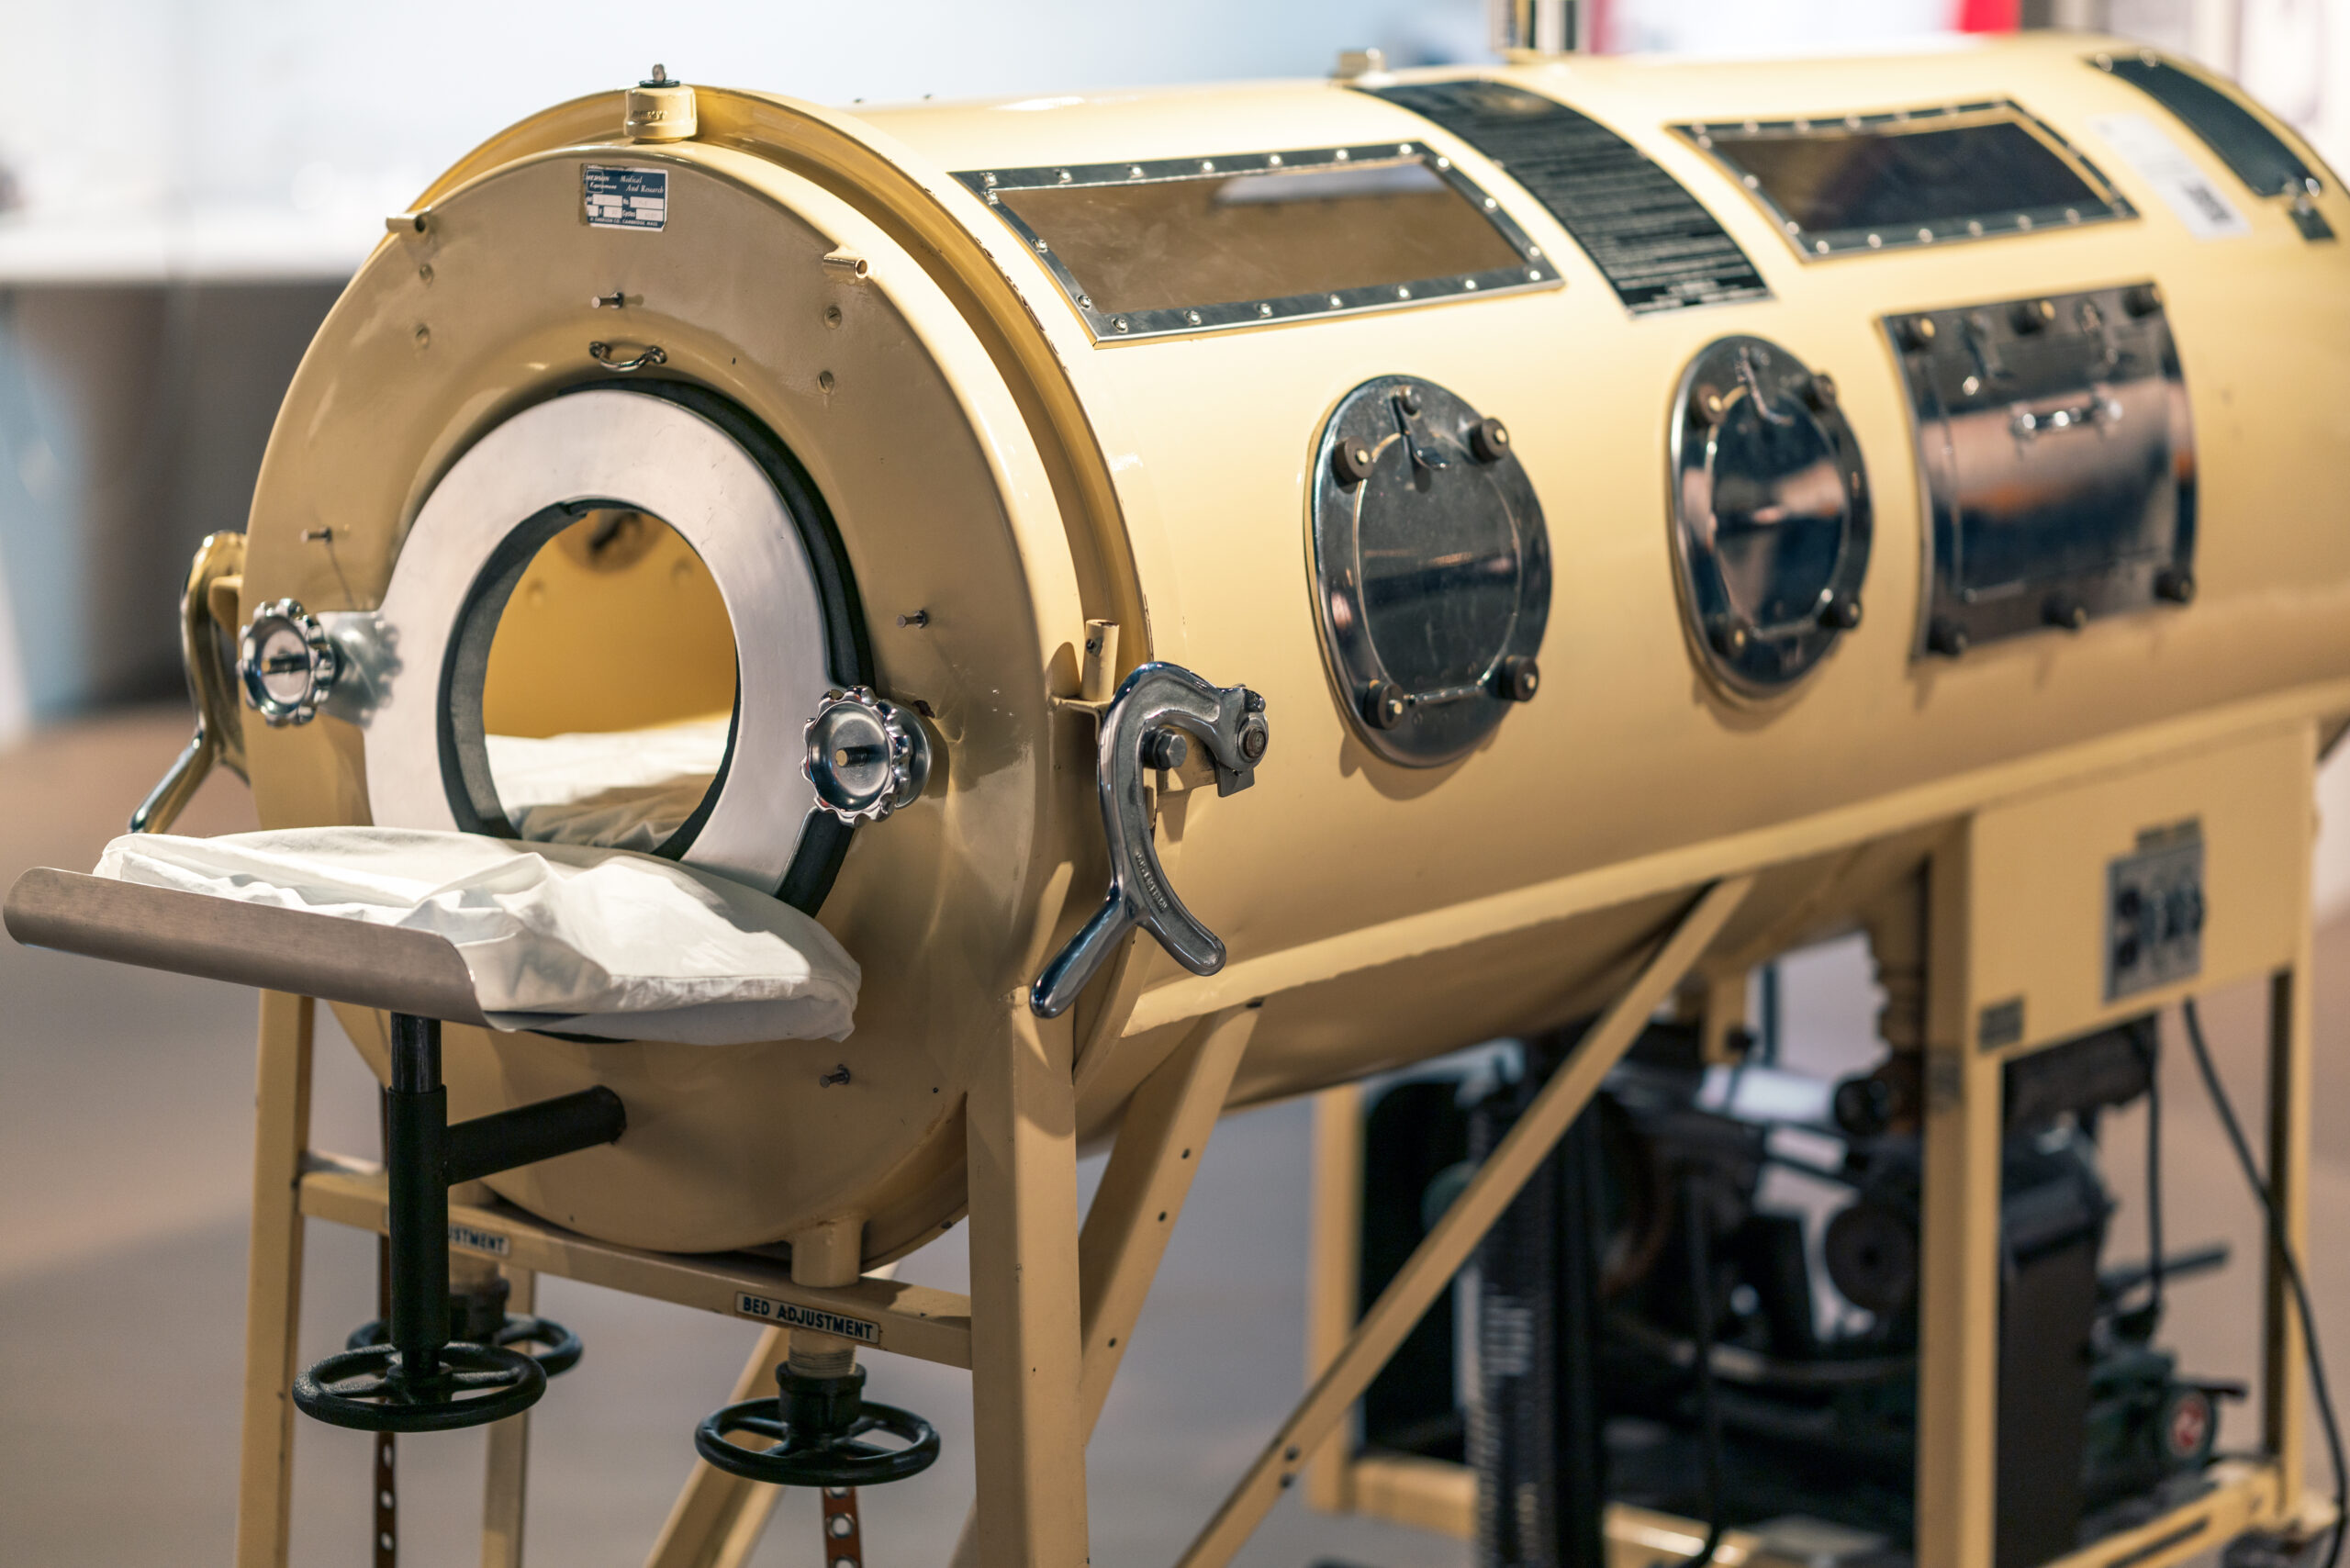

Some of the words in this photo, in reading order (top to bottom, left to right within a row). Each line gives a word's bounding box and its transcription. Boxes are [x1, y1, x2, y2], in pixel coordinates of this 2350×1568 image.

[620, 175, 643, 184] Medical
[641, 185, 665, 194] Research
[743, 1295, 770, 1316] BED
[777, 1305, 873, 1340] ADJUSTMENT
